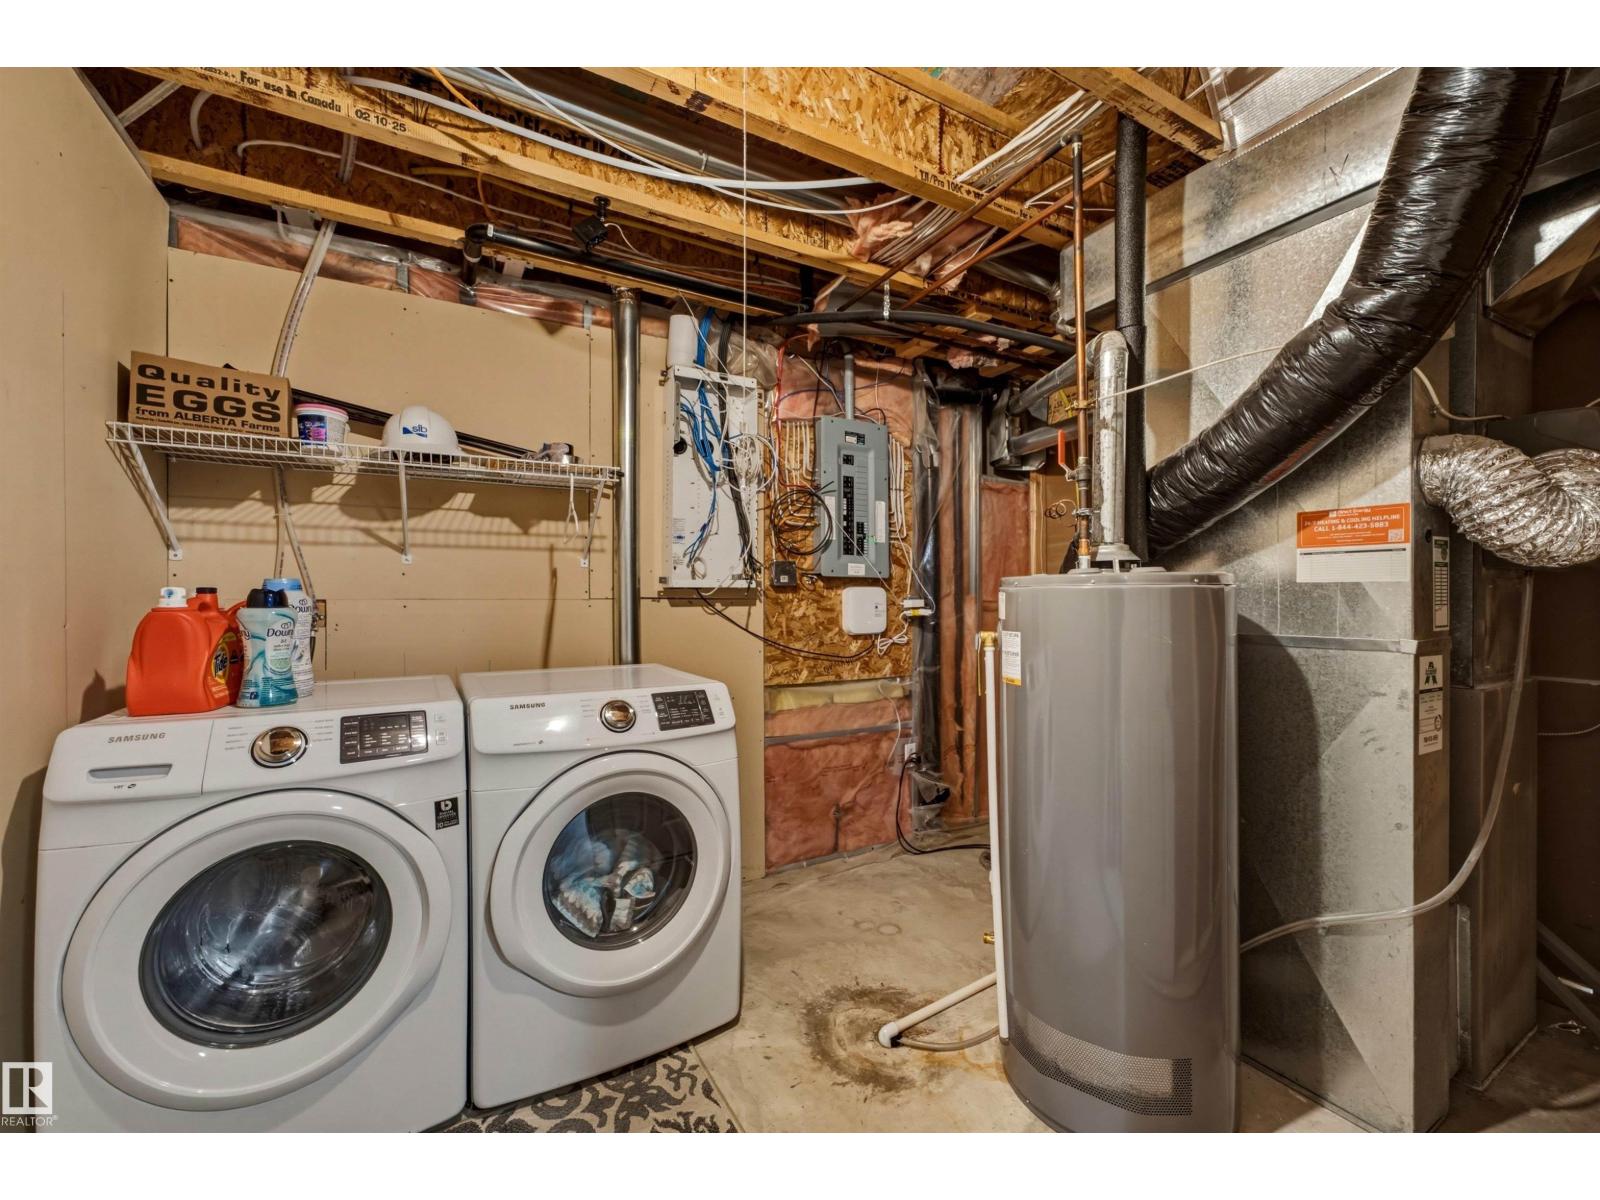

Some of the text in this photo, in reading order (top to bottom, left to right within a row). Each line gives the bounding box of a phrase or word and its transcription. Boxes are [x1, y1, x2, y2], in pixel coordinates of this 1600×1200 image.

[240, 70, 260, 86] For
[263, 81, 284, 94] use
[300, 91, 342, 113] Canada
[354, 109, 371, 122] 02
[137, 364, 281, 402] Quality
[136, 383, 281, 423] EGGS
[135, 406, 169, 418] from
[174, 411, 237, 428] ALBERTA
[241, 420, 281, 432] Farms
[266, 628, 294, 639] Down
[509, 702, 546, 710] SAMSUNG
[107, 732, 166, 743] SAMSUNG
